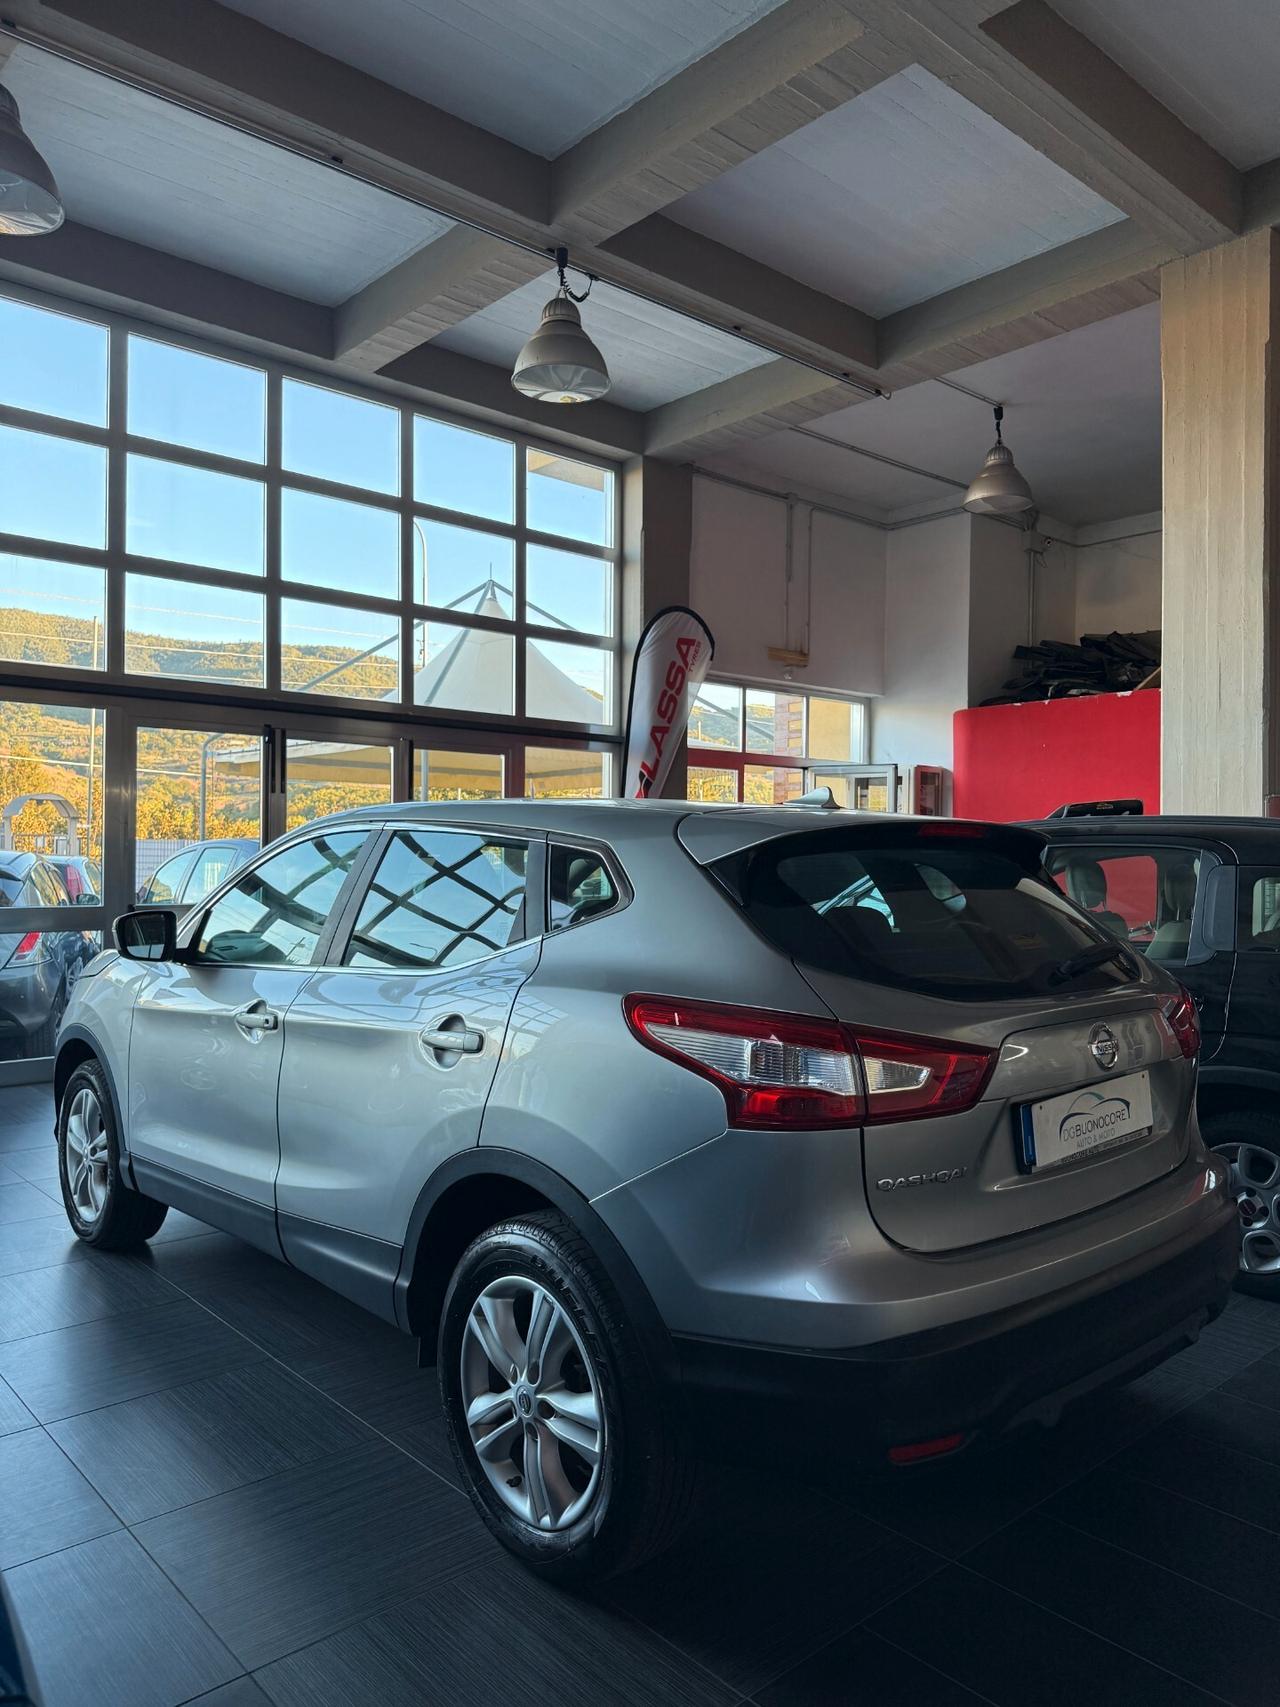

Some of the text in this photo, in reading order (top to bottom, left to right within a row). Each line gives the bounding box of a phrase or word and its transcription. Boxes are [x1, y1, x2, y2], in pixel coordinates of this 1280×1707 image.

[688, 640, 703, 673] TYRES
[640, 637, 697, 782] LASSA
[877, 1167, 968, 1192] QASHQAI
